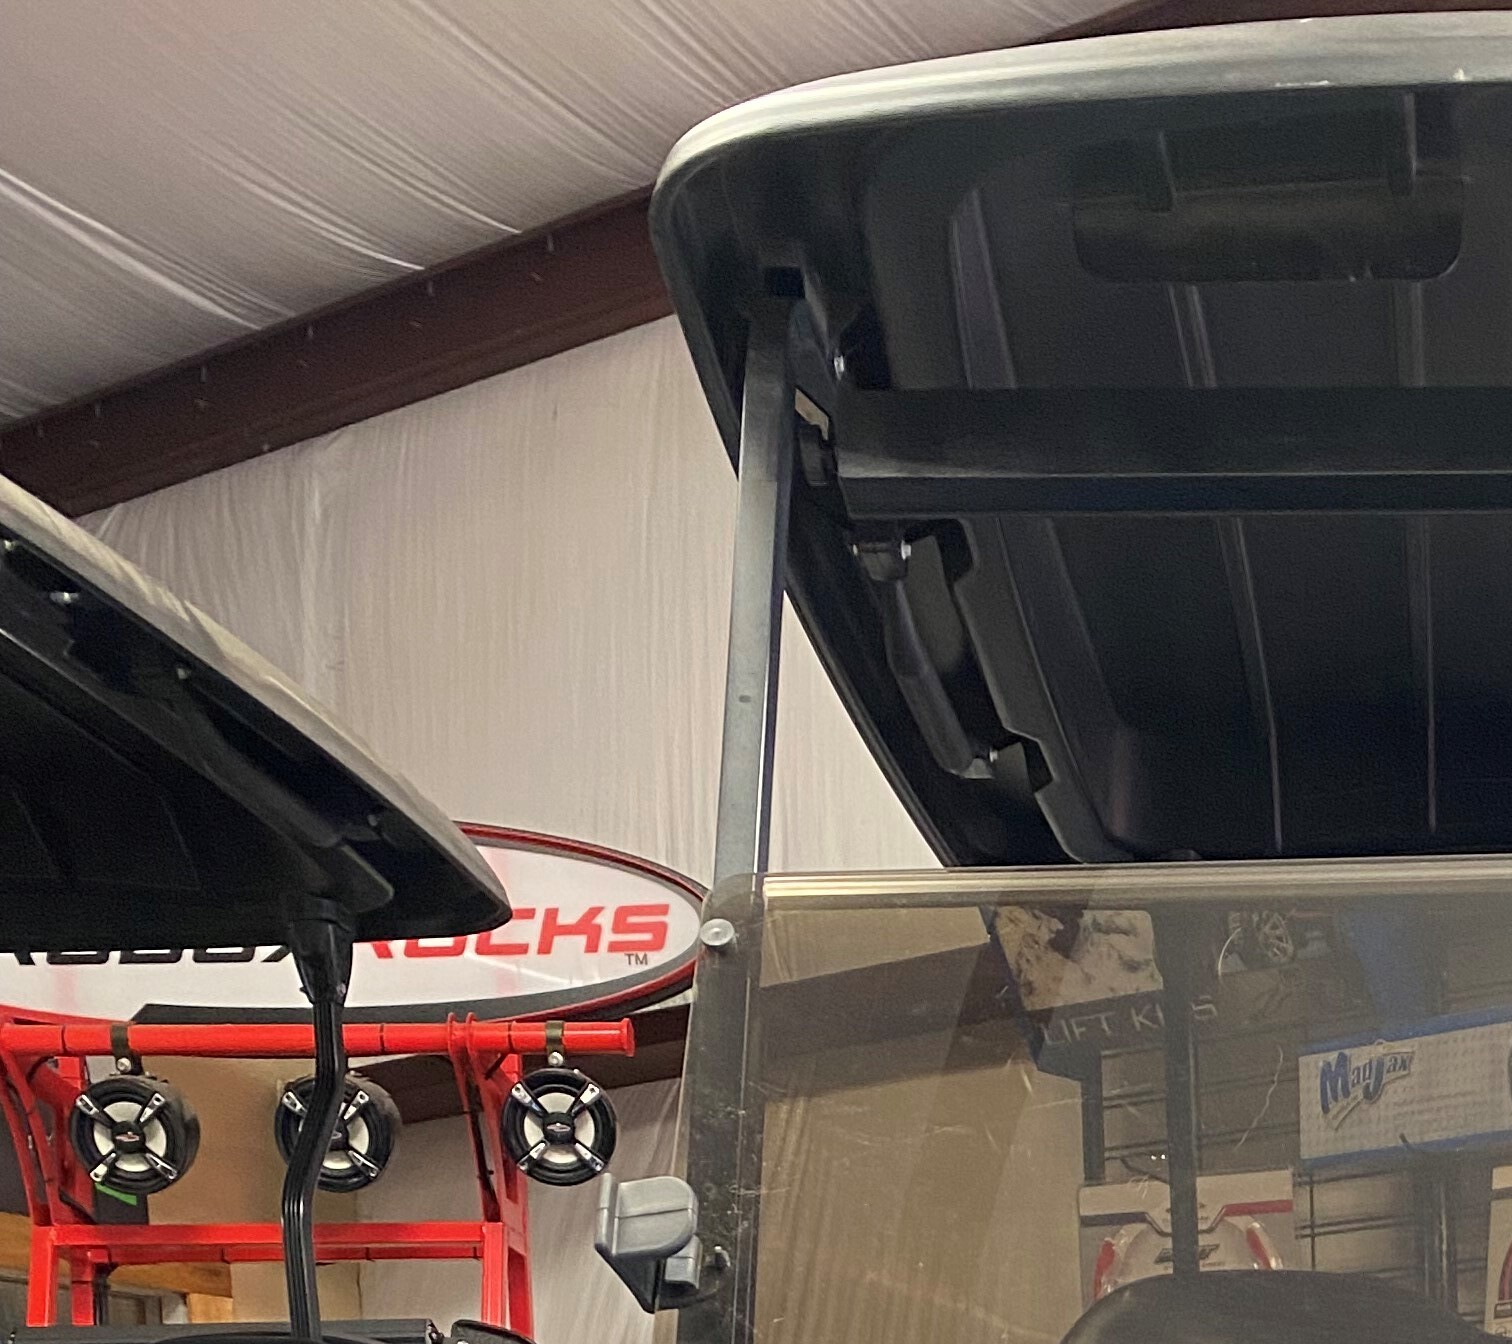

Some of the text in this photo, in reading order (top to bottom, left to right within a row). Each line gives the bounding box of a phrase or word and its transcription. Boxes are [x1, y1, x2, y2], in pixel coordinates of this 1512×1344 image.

[624, 953, 648, 967] TM
[1040, 994, 1218, 1044] LIFT KIS
[1319, 1051, 1414, 1115] MadJax
